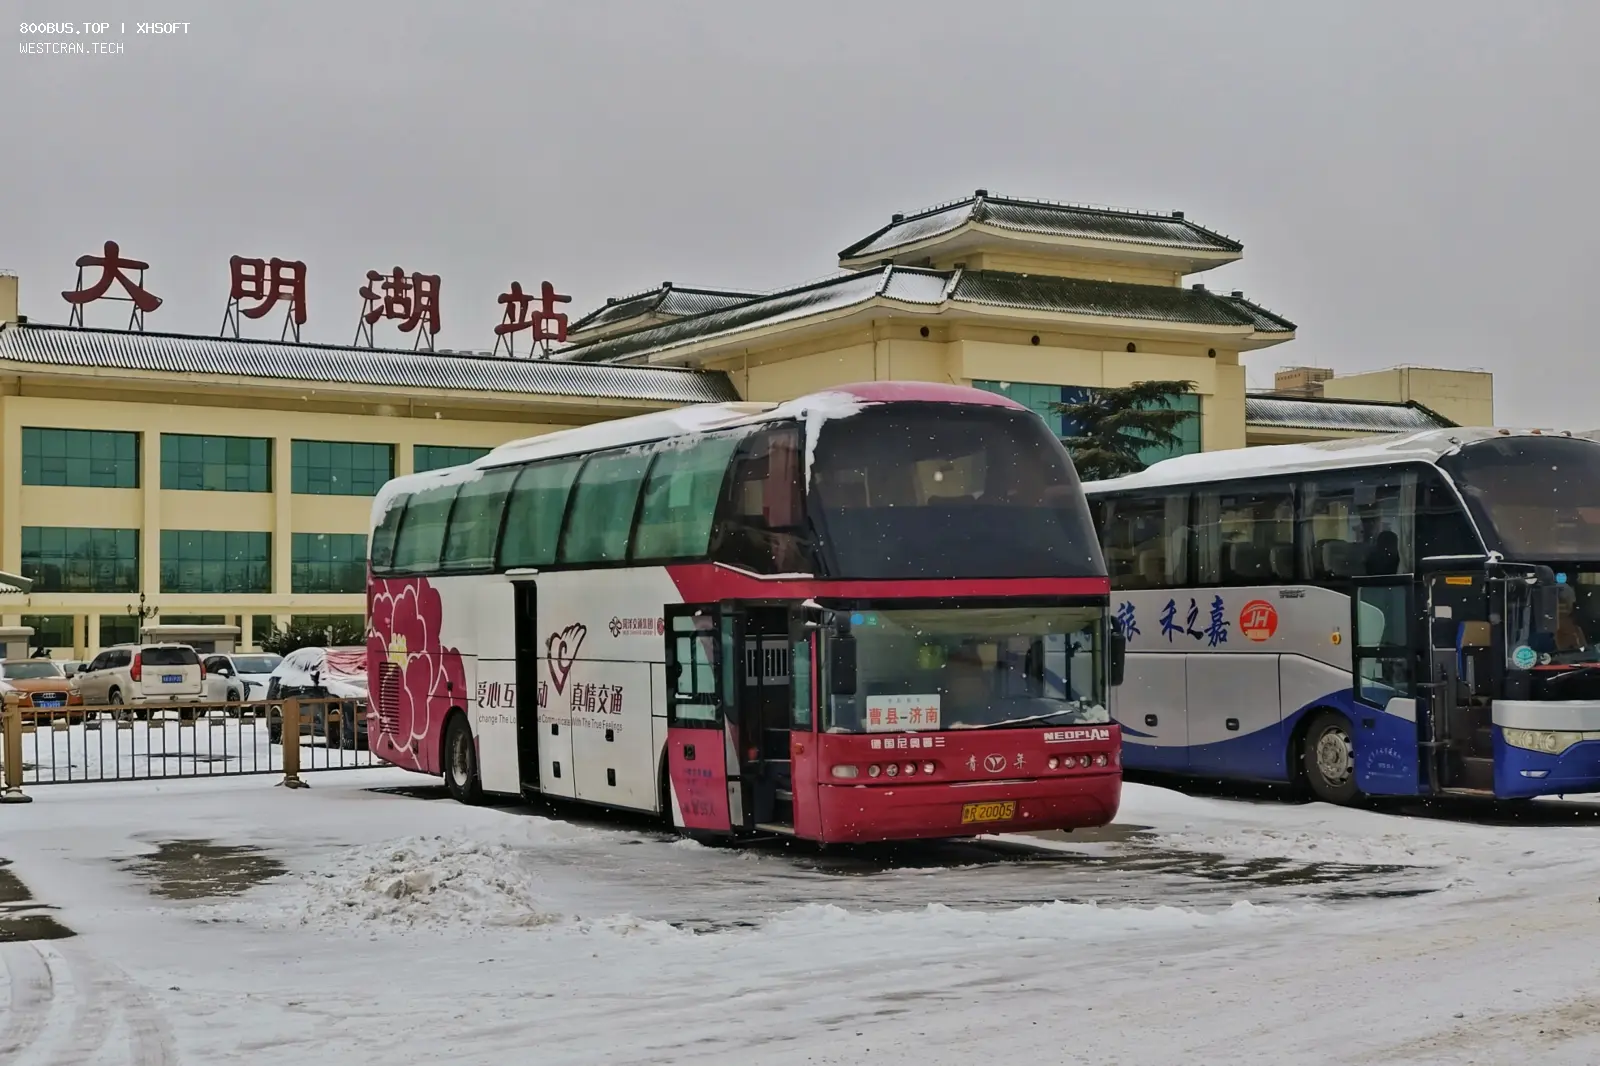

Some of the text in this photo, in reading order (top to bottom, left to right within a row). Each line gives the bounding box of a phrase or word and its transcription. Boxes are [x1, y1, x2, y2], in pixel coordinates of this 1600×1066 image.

[62, 240, 572, 342] 大明湖站
[1242, 610, 1270, 628] JH
[571, 681, 624, 715] 真情交通
[1043, 728, 1110, 743] NEOPLAN
